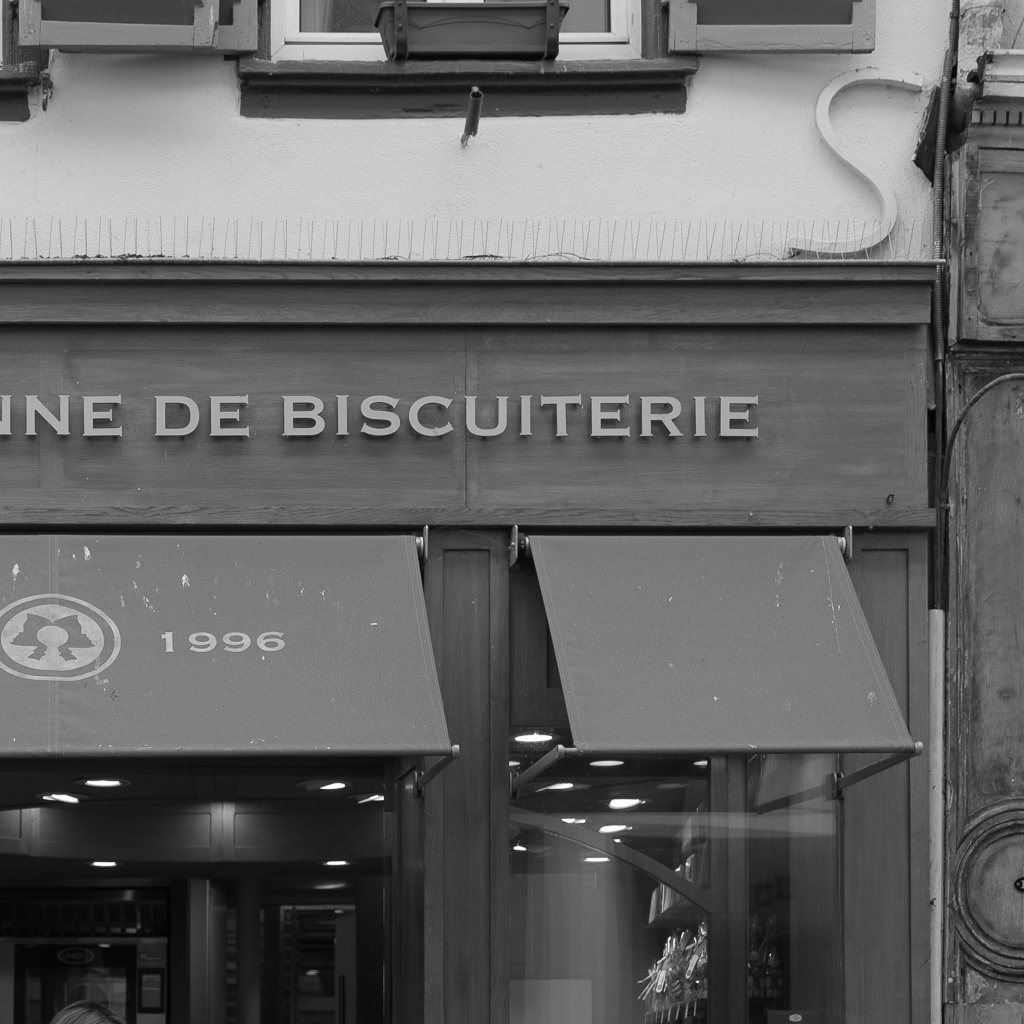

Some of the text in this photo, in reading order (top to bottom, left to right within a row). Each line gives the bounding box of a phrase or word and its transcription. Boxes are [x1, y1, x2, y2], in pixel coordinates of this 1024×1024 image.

[155, 393, 250, 438] DE
[282, 393, 759, 438] BISCUITERIE
[161, 631, 286, 653] 1996
